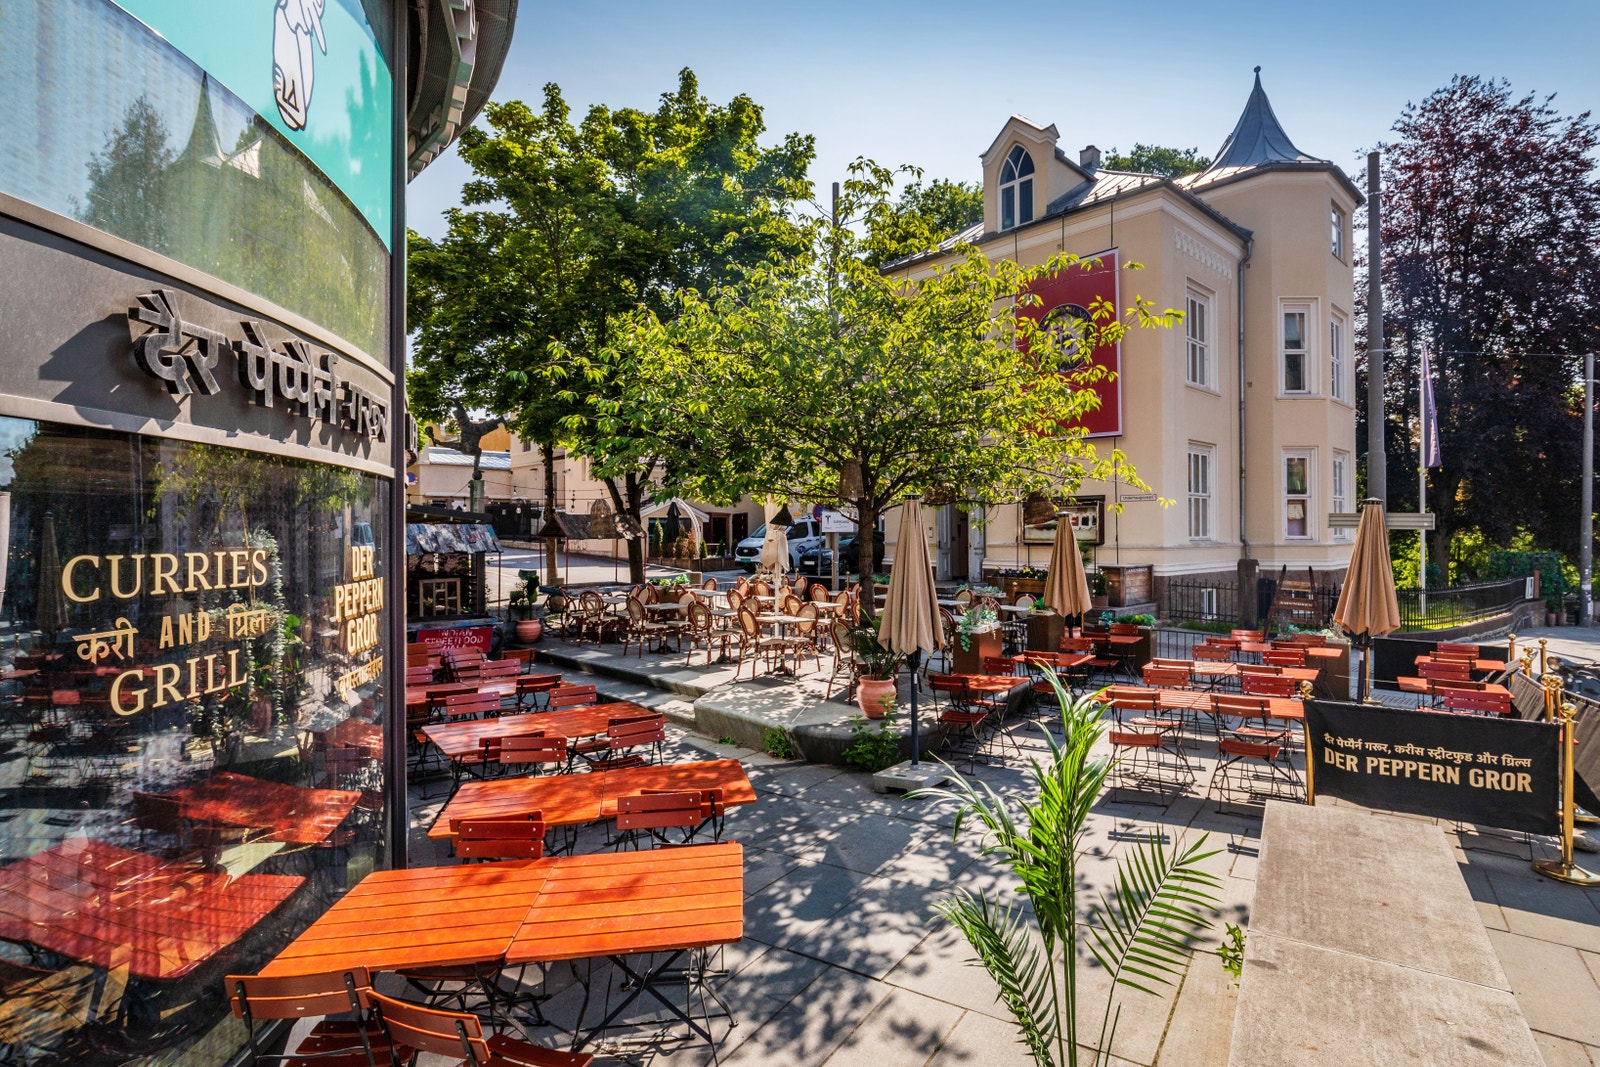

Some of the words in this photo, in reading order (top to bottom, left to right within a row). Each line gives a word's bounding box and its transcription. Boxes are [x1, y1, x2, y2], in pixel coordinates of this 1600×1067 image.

[61, 550, 268, 602] CURRIES
[351, 545, 375, 582] DER
[335, 576, 385, 623] PEPPERN
[72, 616, 139, 664] करी
[159, 611, 210, 649] AND
[225, 603, 267, 639] ग्रिल
[347, 613, 379, 656] GROR
[110, 649, 248, 716] GRILL
[1323, 746, 1359, 773] DER
[1365, 756, 1461, 785] PEPPERN
[1468, 768, 1533, 793] GROR
[1394, 743, 1425, 756] करीस
[1476, 751, 1499, 764] और
